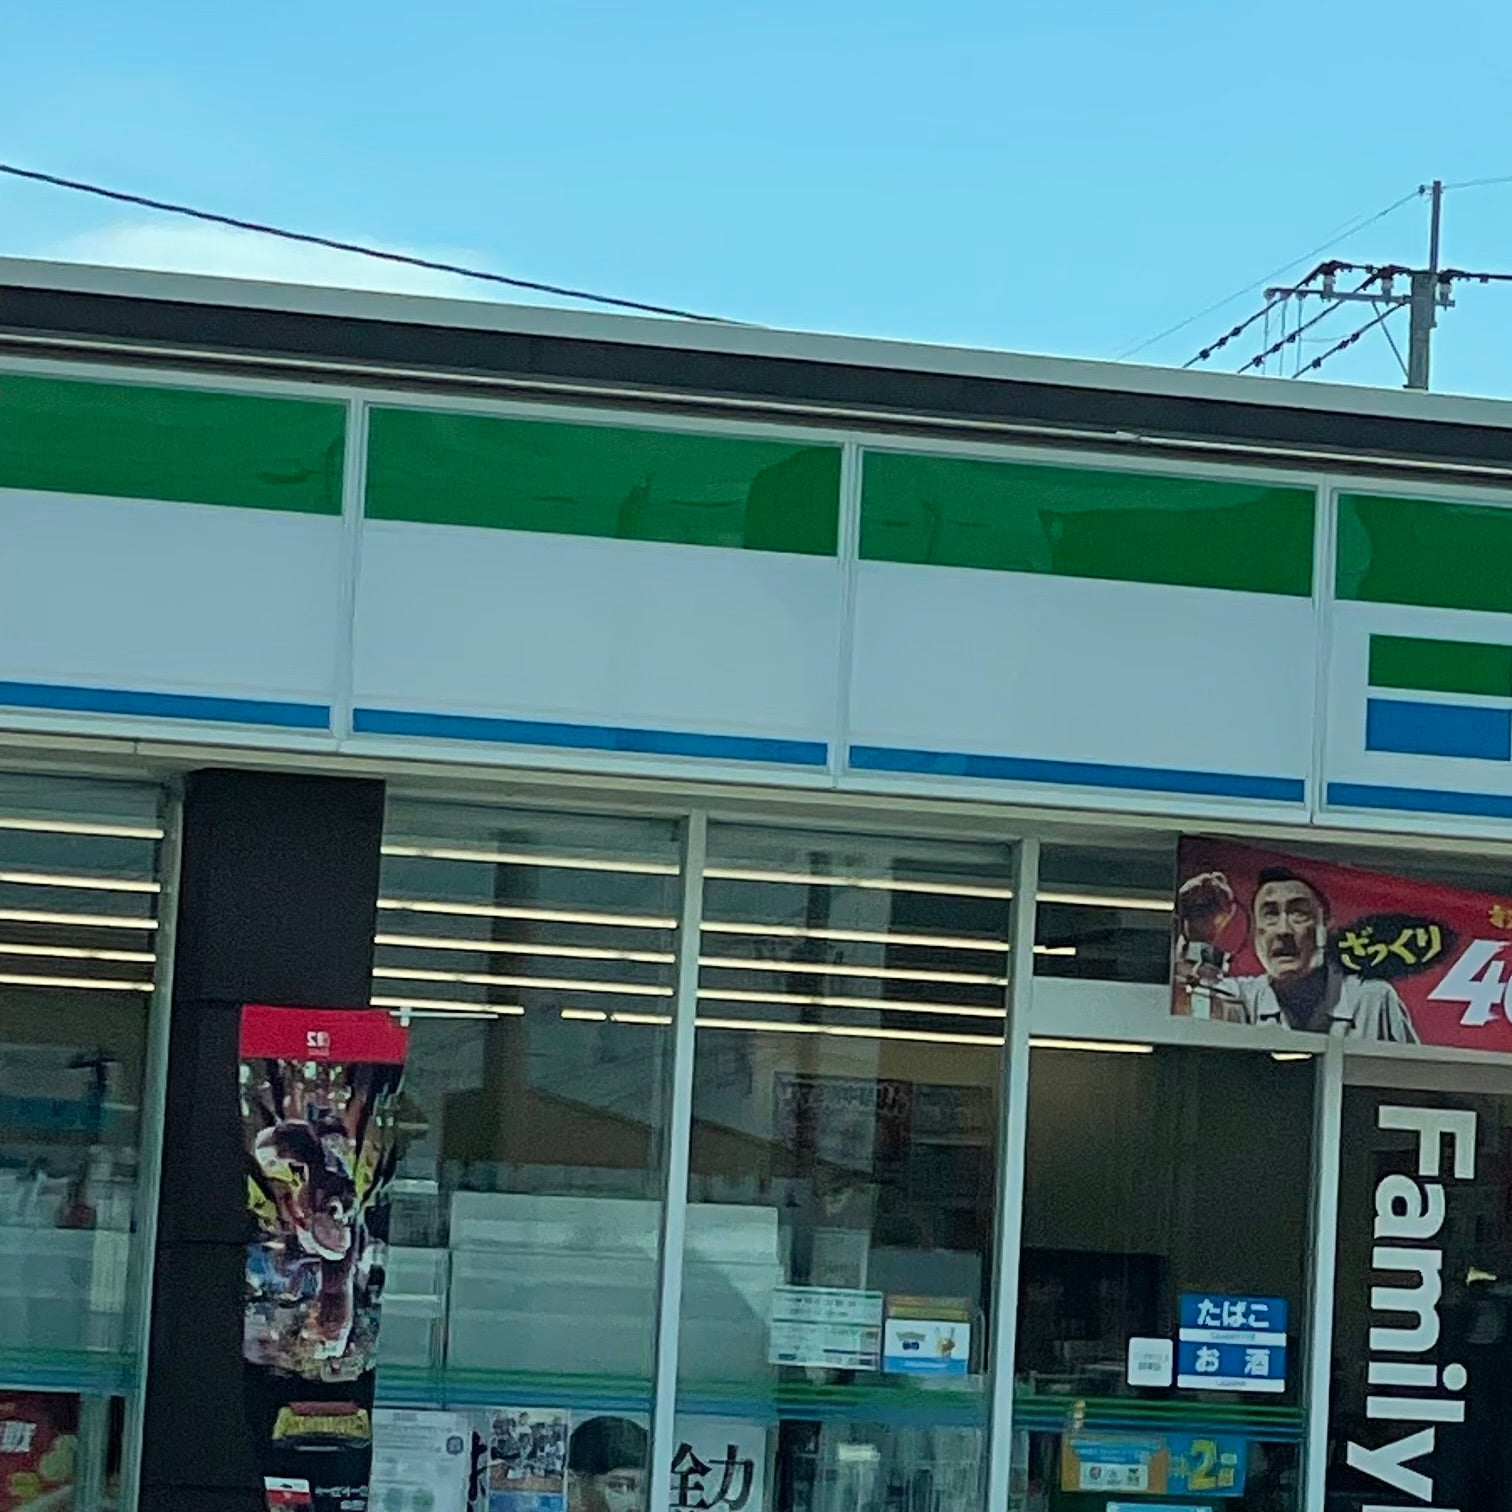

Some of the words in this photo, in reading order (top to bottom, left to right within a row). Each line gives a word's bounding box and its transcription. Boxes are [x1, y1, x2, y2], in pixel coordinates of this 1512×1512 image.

[1337, 924, 1442, 971] ざっくり
[1197, 1298, 1270, 1328] たばこ
[1346, 1105, 1478, 1512] Family
[1194, 1346, 1271, 1377] お酒
